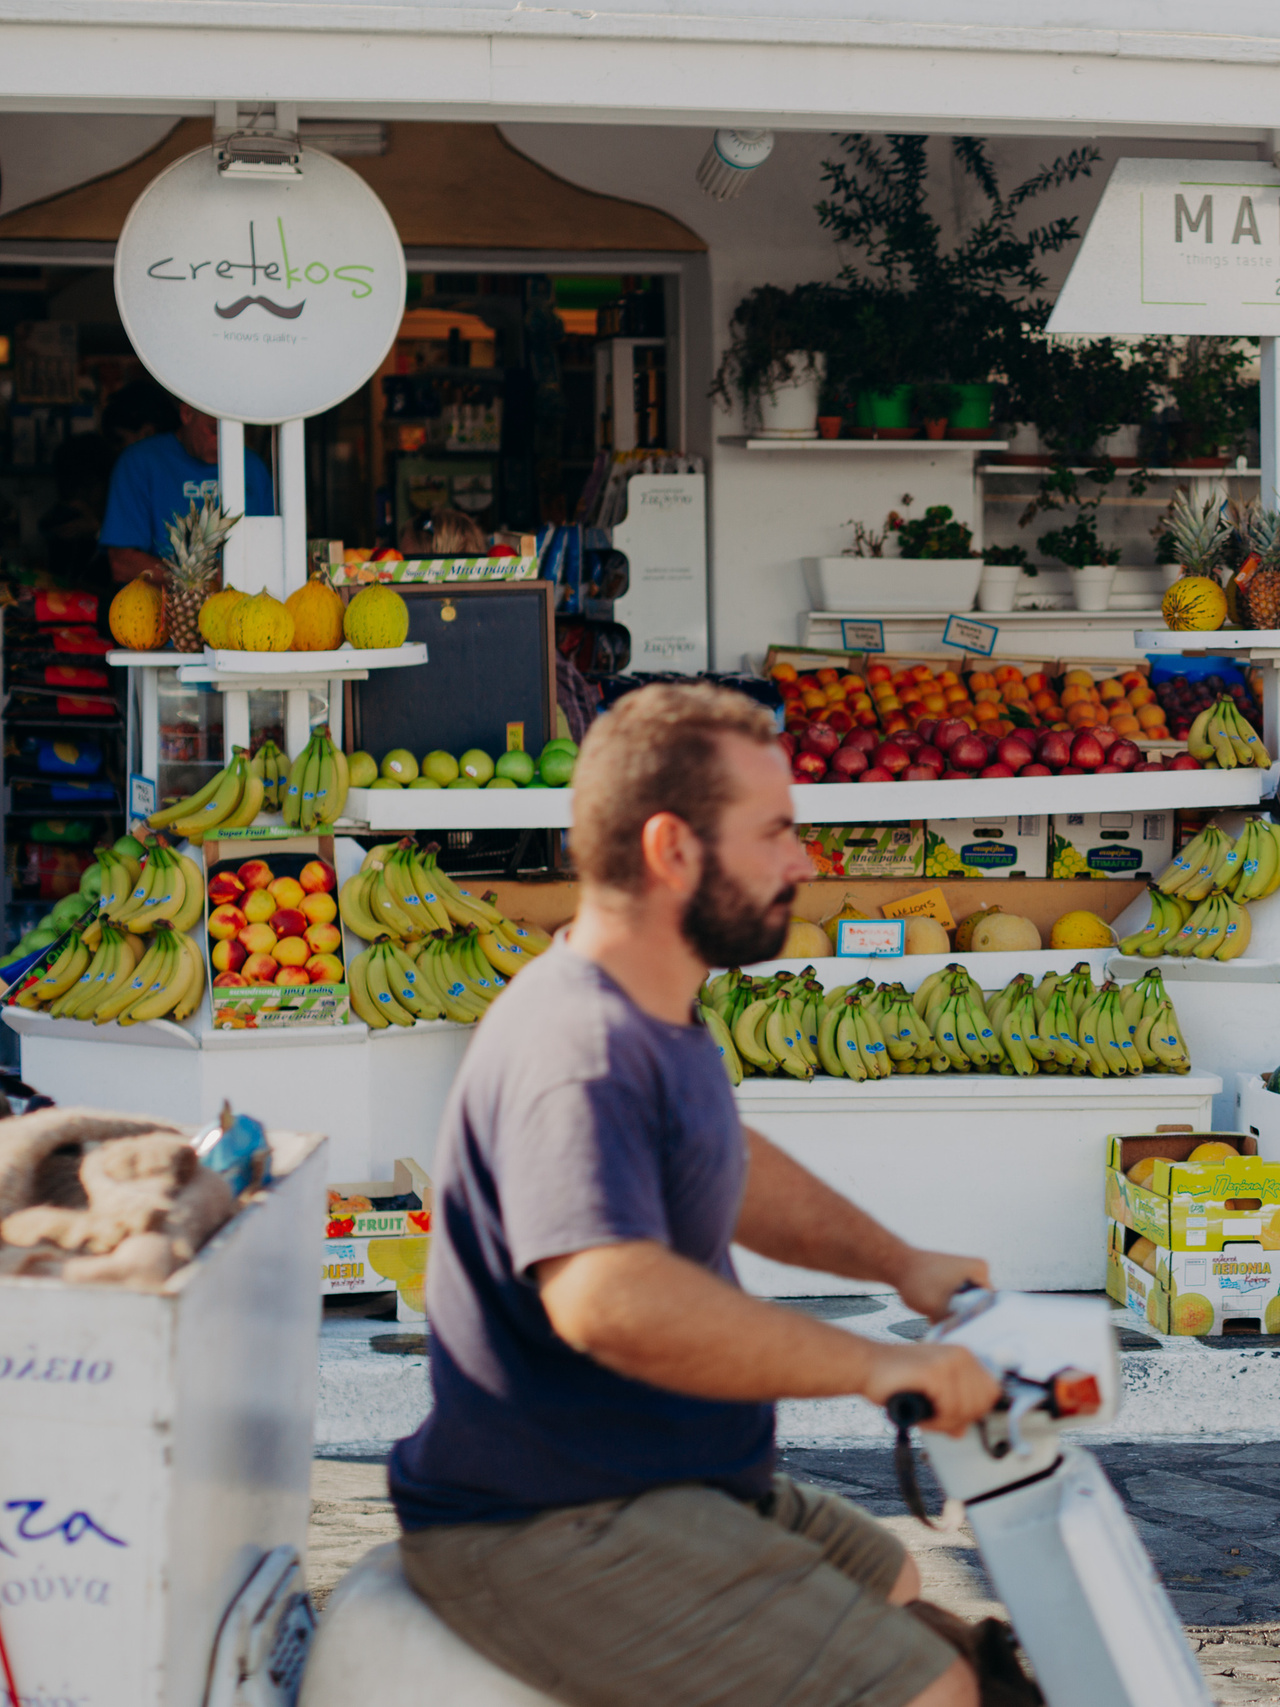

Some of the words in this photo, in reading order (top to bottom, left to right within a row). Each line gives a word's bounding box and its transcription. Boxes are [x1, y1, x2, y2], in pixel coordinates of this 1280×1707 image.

[147, 216, 374, 299] cretekos
[1236, 254, 1273, 267] taste
[223, 330, 259, 342] knows
[263, 331, 297, 344] quality
[405, 567, 426, 578] Super
[427, 567, 445, 577] Fruit
[245, 829, 266, 837] Fruit
[964, 856, 1013, 865] ΣΤΙΜΑΓΚΑΣ
[1091, 859, 1138, 868] ΣΤΙΜΑΓΚΑΣ
[891, 899, 936, 918] MELONS
[357, 1217, 404, 1231] FRUIT
[1212, 1262, 1271, 1276] ΠΕΠΟΝΙΑ
